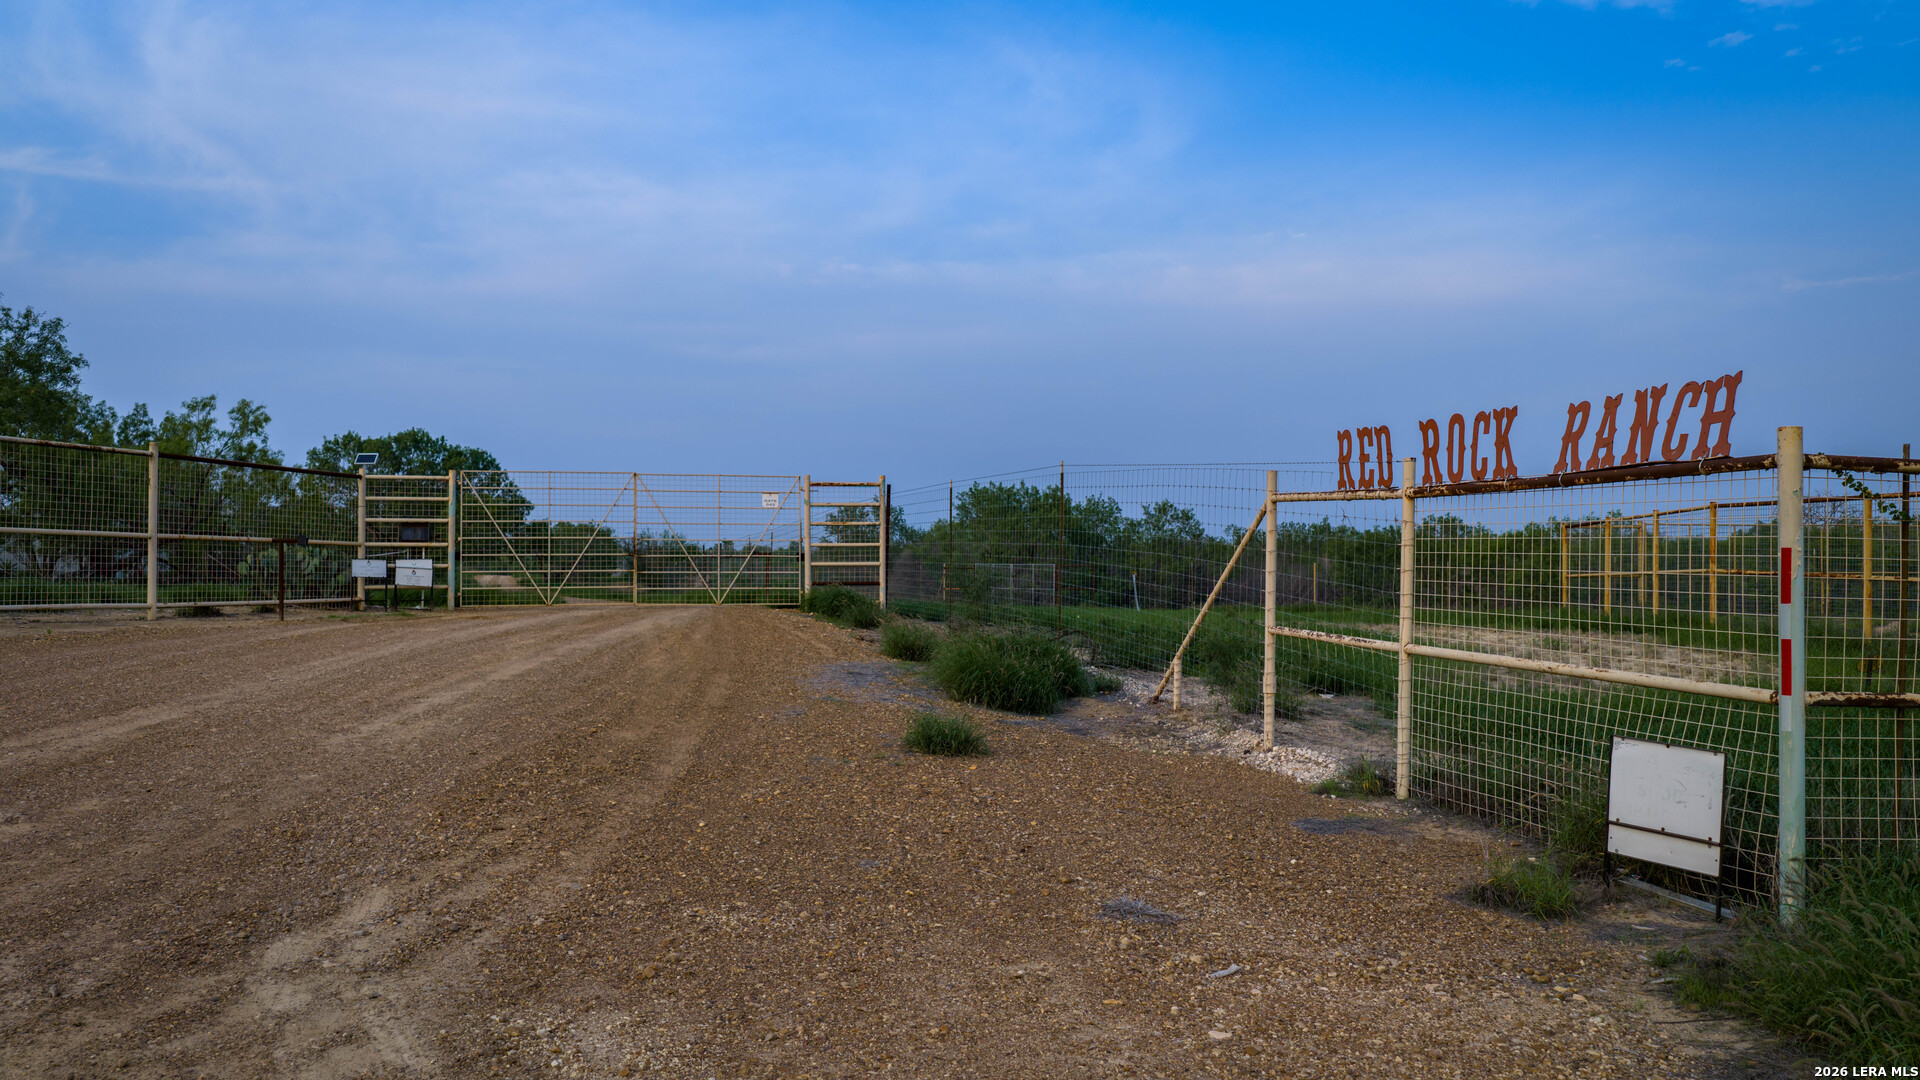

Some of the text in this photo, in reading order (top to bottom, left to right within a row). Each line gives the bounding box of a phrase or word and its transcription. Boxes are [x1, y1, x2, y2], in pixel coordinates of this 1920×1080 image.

[1337, 370, 1743, 490] RED ROCK RANCH
